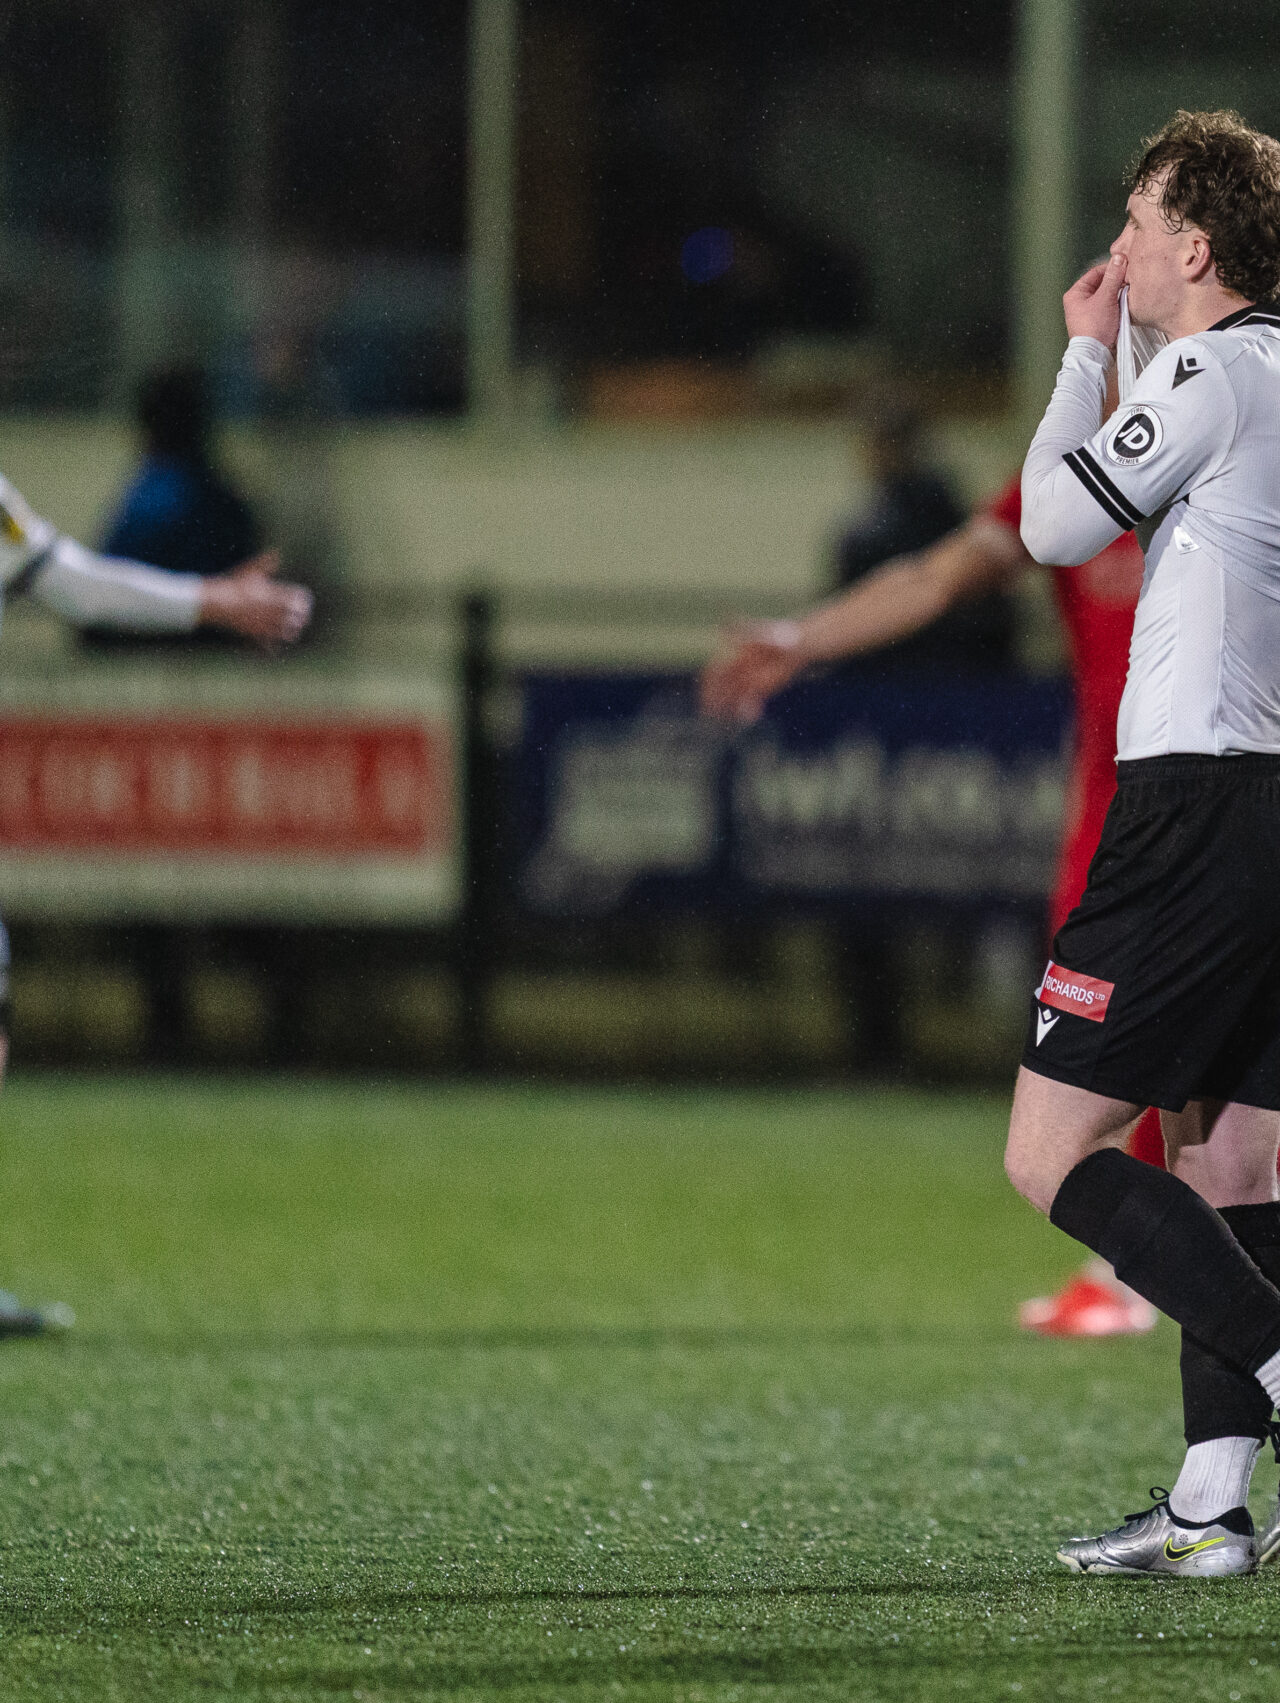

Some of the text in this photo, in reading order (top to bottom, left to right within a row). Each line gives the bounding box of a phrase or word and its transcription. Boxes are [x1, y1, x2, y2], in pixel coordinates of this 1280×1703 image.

[1115, 455, 1140, 465] PREMIER
[1044, 975, 1106, 1005] RICHARDS LTD
